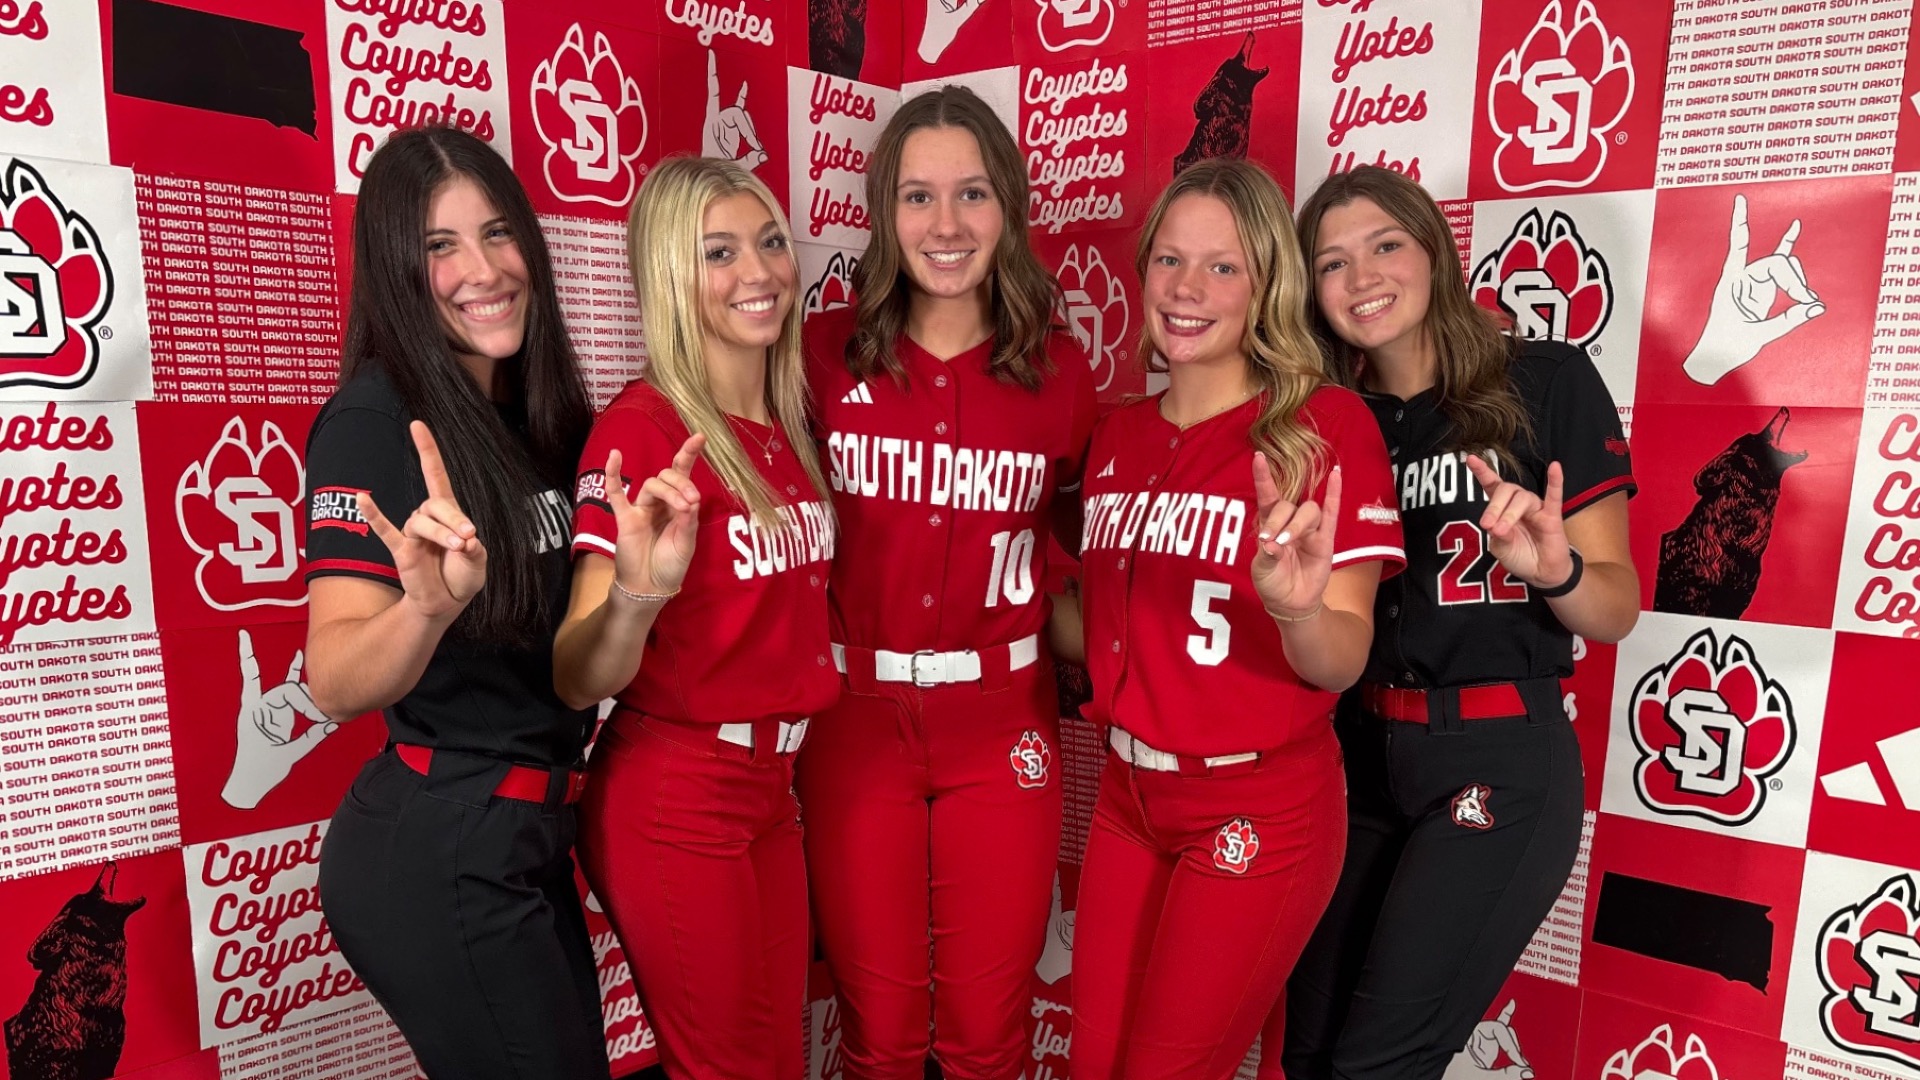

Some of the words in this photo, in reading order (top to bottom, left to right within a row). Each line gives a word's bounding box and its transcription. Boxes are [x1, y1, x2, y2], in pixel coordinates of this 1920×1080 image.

[1167, 16, 1194, 26] DAKOTA
[1197, 12, 1221, 21] SOUTH
[1223, 6, 1252, 16] DAKOTA
[1254, 1, 1279, 11] SOUTH
[1167, 28, 1194, 38] DAKOTA
[1197, 24, 1221, 33] SOUTH
[1223, 18, 1252, 28] DAKOTA
[1254, 14, 1279, 23] SOUTH
[1693, 30, 1736, 42] DAKOTA
[1739, 25, 1776, 36] SOUTH
[1779, 20, 1825, 32] DAKOTA
[1828, 15, 1867, 26] SOUTH
[1870, 9, 1909, 21] DAKOT
[341, 23, 492, 96] Coyotes
[1332, 16, 1433, 83] Yotes
[1690, 61, 1733, 72] DAKOTA
[1735, 56, 1772, 68] SOUTH
[1776, 51, 1821, 64] DAKOTA
[1824, 47, 1863, 58] SOUTH
[1866, 42, 1905, 54] DAKOT
[809, 73, 875, 124] Yotes
[1025, 58, 1127, 116] Coyotes
[1686, 95, 1729, 106] DAKOTA
[1732, 91, 1768, 102] SOUTH
[1772, 86, 1817, 98] DAKOTA
[1820, 82, 1858, 93] SOUTH
[1862, 78, 1901, 89] DAKOT
[1026, 102, 1127, 158] Coyotes
[1327, 83, 1427, 147] Yotes
[1682, 128, 1725, 138] DAKOTA
[1728, 124, 1764, 134] SOUTH
[1768, 120, 1813, 131] DAKOTA
[1816, 116, 1854, 127] SOUTH
[1858, 113, 1897, 123] DAKOT
[1028, 144, 1124, 198] Coyotes
[1678, 160, 1721, 170] DAKOTA
[1724, 157, 1761, 167] SOUTH
[1764, 153, 1809, 164] DAKOTA
[1811, 150, 1850, 160] SOUTH
[1854, 147, 1893, 157] DAKOT
[155, 177, 201, 189] DAKOTA
[204, 182, 241, 194] SOUTH
[245, 187, 287, 199] DAKOTA
[289, 193, 323, 203] SOUTH
[157, 204, 202, 216] DAKOTA
[206, 208, 243, 220] SOUTH
[246, 213, 288, 224] DAKOTA
[290, 218, 324, 228] SOUTH
[1029, 185, 1123, 234] Coyotes
[160, 232, 205, 243] DAKOTA
[209, 236, 246, 247] SOUTH
[249, 240, 291, 251] DAKOTA
[293, 244, 327, 254] SOUTH
[164, 259, 209, 269] DAKOTA
[213, 262, 249, 273] SOUTH
[253, 266, 295, 276] DAKOTA
[297, 269, 331, 279] SOUTH
[166, 285, 211, 296] DAKOTA
[215, 288, 251, 298] SOUTH
[254, 291, 296, 301] DAKOTA
[298, 294, 332, 304] SOUTH
[170, 313, 214, 323] DAKOTA
[218, 316, 254, 325] SOUTH
[257, 318, 299, 327] DAKOTA
[301, 320, 334, 330] SOUTH
[175, 342, 220, 351] DAKOTA
[224, 344, 260, 353] SOUTH
[264, 346, 304, 355] DAKOTA
[828, 431, 923, 502] SOUTH
[930, 443, 1046, 512] DAKOTA
[312, 492, 360, 509] SOUT
[1080, 492, 1133, 554] OUTH
[1119, 491, 1246, 566] DAKOTA
[985, 528, 1035, 608] 10
[1186, 579, 1232, 667] 5
[0, 729, 42, 741] SOUTH
[46, 722, 94, 735] DAKOTA
[97, 716, 136, 728] SOUTH
[4, 759, 46, 772] SOUTH
[50, 752, 98, 765] DAKOTA
[101, 745, 139, 757] SOUTH
[8, 791, 49, 804] SOUTH
[53, 783, 101, 797] DAKOTA
[104, 777, 142, 789] SOUTH
[12, 824, 53, 838] SOUTH
[57, 815, 104, 830] DAKOTA
[107, 808, 146, 821] SOUTH
[14, 839, 55, 853] SOUTH
[59, 830, 106, 845] DAKOTA
[109, 823, 147, 836] SOUTH
[202, 824, 321, 894] Coyot
[1549, 967, 1577, 978] DAKOT
[238, 1042, 278, 1058] DAKOTA
[280, 1031, 312, 1046] SOUTH
[315, 1020, 351, 1035] DAKOTA
[353, 1011, 383, 1024] SOUTH
[239, 1055, 279, 1071] DAKOTA
[281, 1045, 313, 1059] SOUTH
[315, 1033, 352, 1048] DAKOTA
[354, 1024, 384, 1037] SOUTH
[1810, 1055, 1852, 1071] DAKOTA
